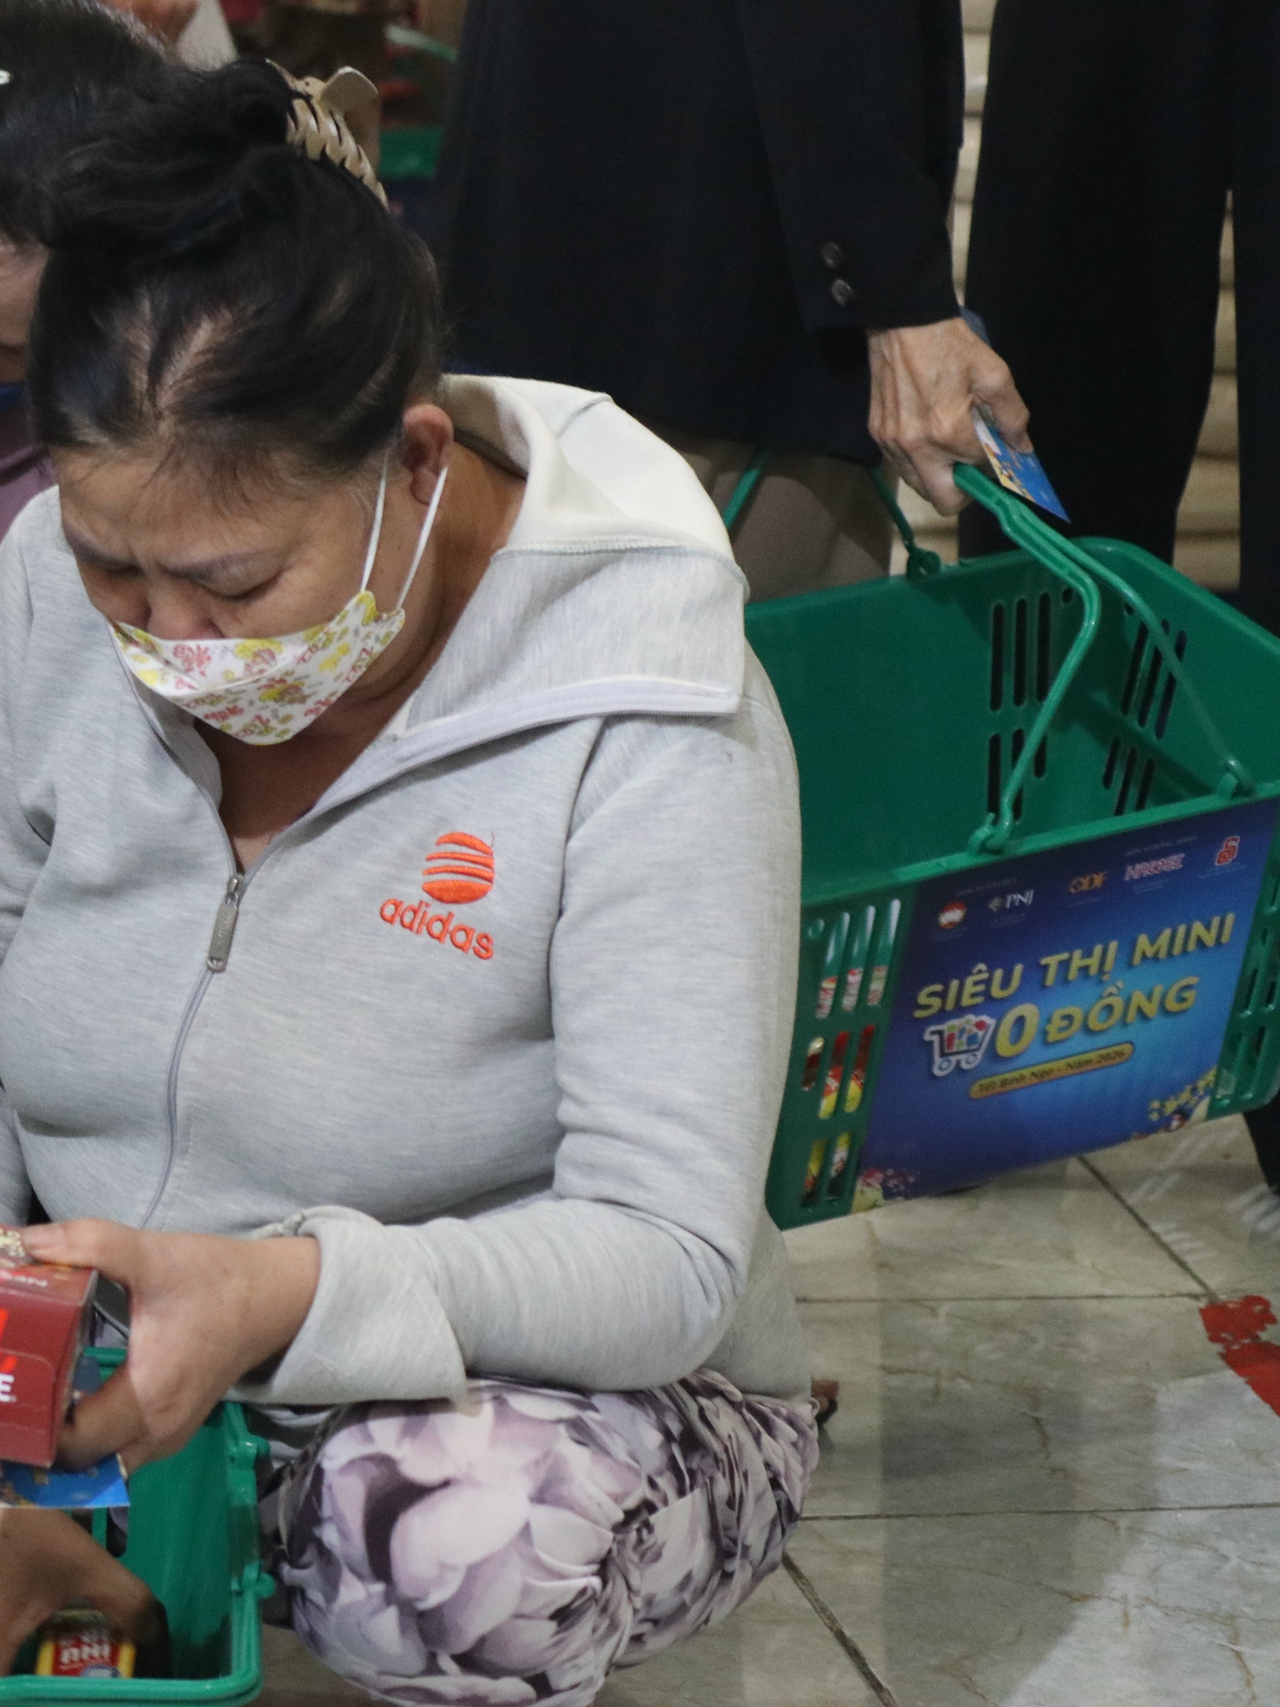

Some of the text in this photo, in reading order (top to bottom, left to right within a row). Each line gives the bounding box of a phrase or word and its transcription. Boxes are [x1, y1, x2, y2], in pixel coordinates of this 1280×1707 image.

[380, 898, 494, 960] adidas
[1005, 889, 1034, 909] PNJ
[912, 912, 1236, 1018] SIÊU THỊ MINI
[995, 976, 1200, 1058] 0 ĐỒNG
